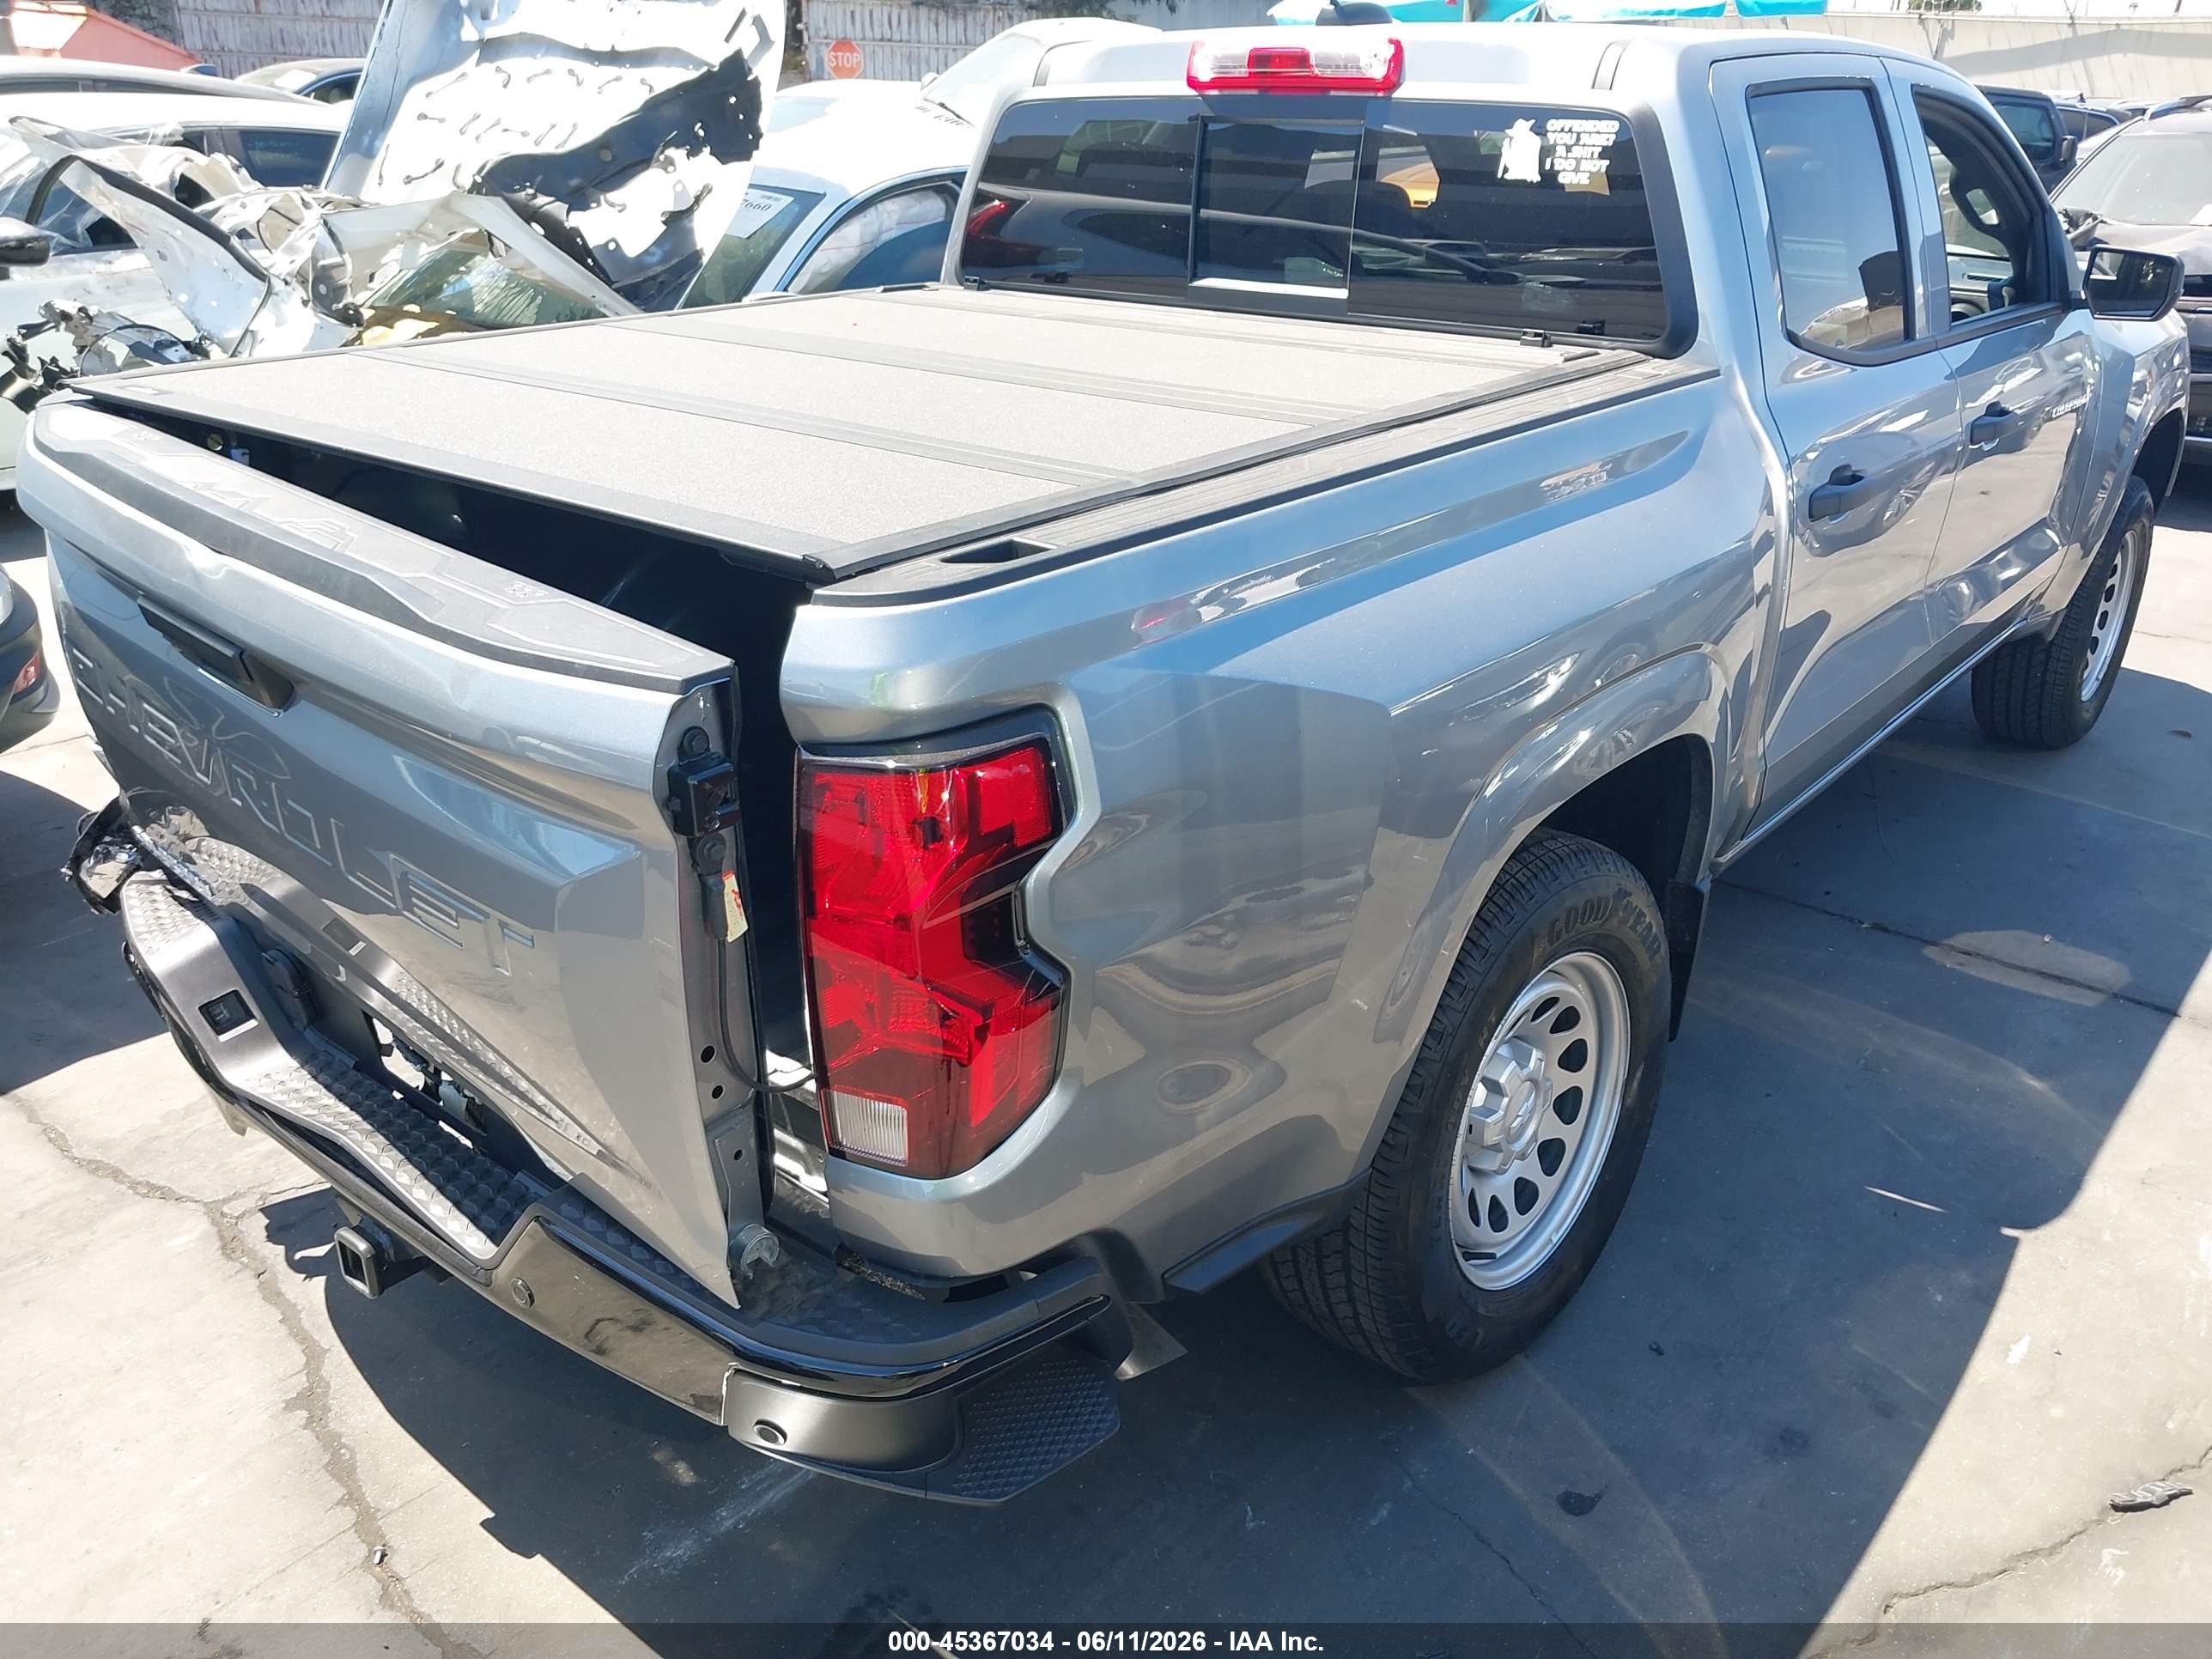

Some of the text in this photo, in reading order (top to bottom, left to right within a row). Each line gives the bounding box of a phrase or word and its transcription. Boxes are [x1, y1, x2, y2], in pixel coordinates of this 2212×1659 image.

[829, 52, 860, 68] STOP
[1547, 119, 1620, 132] OFFENDED
[1547, 132, 1577, 144] YOU
[1555, 145, 1602, 158] A SHIT
[1546, 157, 1610, 172] I DO NOT
[1558, 171, 1590, 185] GIVE
[70, 646, 536, 978] CHEVROLET
